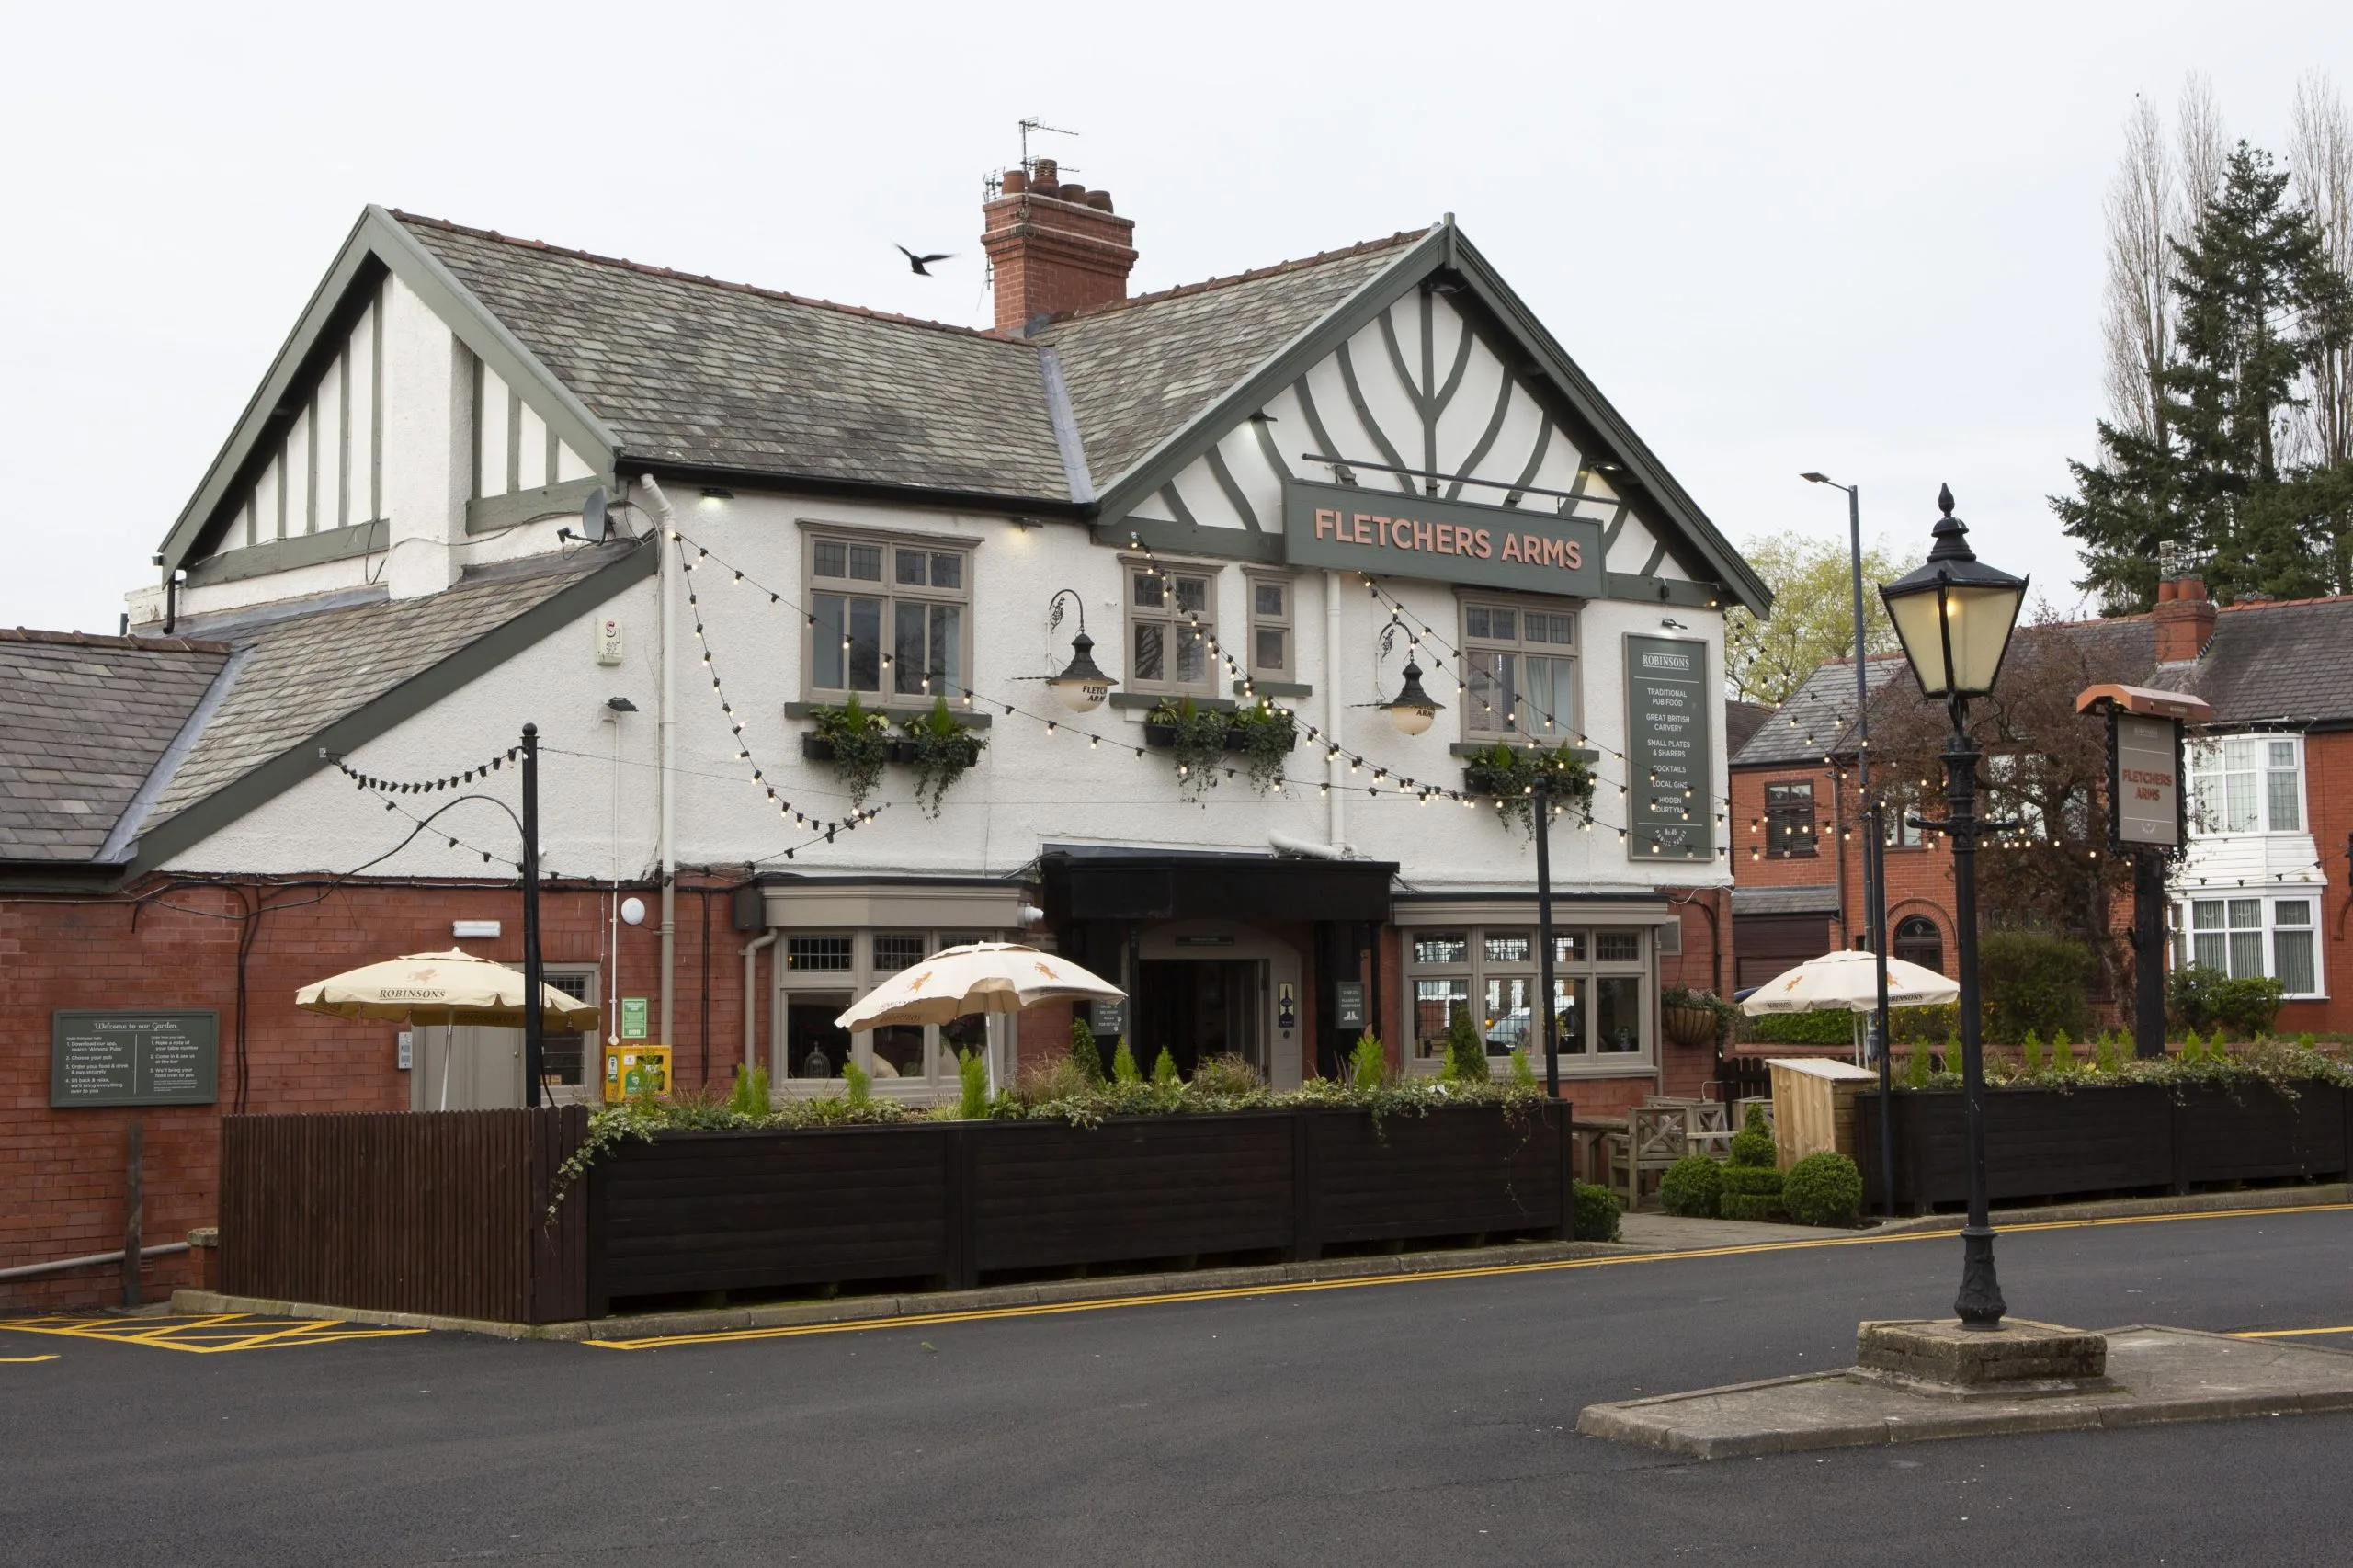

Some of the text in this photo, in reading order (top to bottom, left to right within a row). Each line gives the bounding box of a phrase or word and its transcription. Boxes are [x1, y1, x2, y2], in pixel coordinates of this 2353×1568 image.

[1315, 508, 1582, 570] FLETCHERS ARMS
[1643, 654, 1689, 668] ROBINSONS
[1647, 687, 1688, 698] TRADITIONAL
[1665, 699, 1684, 707] FOOD
[1646, 713, 1690, 723] GREAT BRITISH
[1654, 723, 1682, 732] CARVERY
[1647, 739, 1691, 748] SMALL PLATES
[1653, 765, 1687, 774] COCKTAILS
[2121, 768, 2173, 787] FLETCHERS
[1652, 779, 1672, 788] LOCAL
[2135, 787, 2160, 801] ARMS
[1659, 796, 1682, 804] HIDDEN
[1653, 805, 1686, 814] OURTYAR
[380, 989, 446, 998] ROBINSONS
[1887, 994, 1924, 1002] OBINSONS
[152, 1022, 177, 1031] Garden
